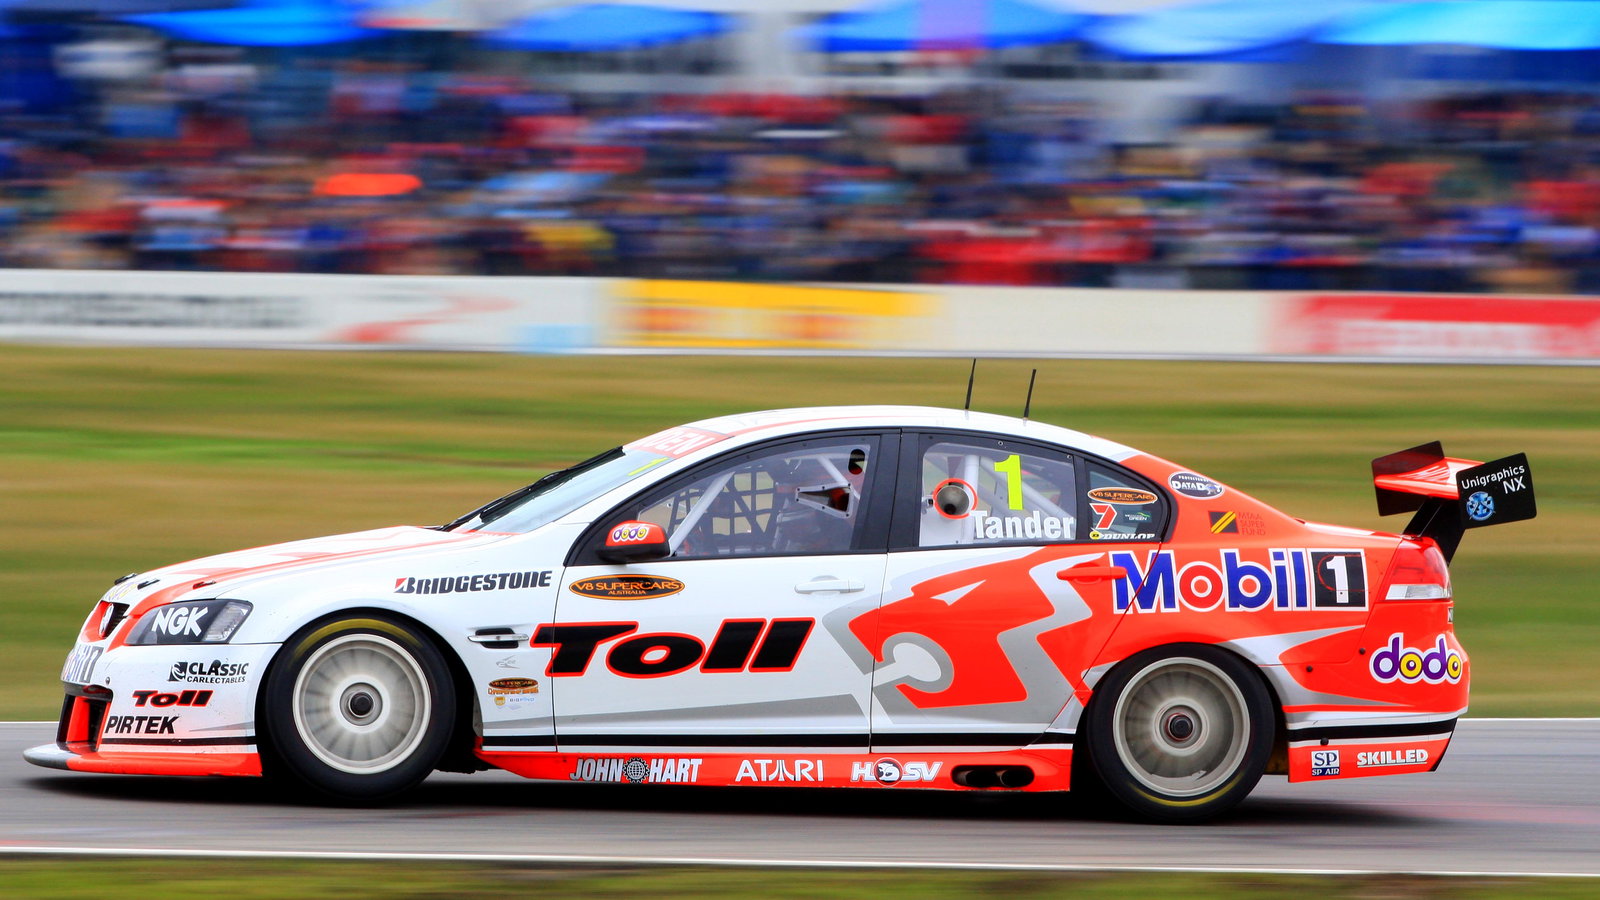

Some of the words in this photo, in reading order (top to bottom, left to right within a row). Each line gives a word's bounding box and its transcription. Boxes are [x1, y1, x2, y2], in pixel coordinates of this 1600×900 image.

[994, 455, 1023, 510] 1
[1461, 465, 1525, 490] Unigraphics
[1503, 476, 1526, 494] NX
[613, 526, 650, 542] dodo
[970, 510, 1074, 539] Tander
[1242, 528, 1267, 536] FUND
[394, 570, 552, 594] BRIDGESTONE
[574, 582, 594, 590] V8
[595, 582, 680, 590] SUPERCARS
[1109, 548, 1308, 614] Mobil
[152, 606, 208, 637] NGK
[530, 617, 816, 679] Toll
[188, 660, 250, 676] CLASSIC
[1369, 632, 1463, 685] dodo
[186, 675, 246, 684] CARLECTABLES
[132, 689, 214, 708] Toll
[104, 715, 181, 734] PIRTEK
[1314, 752, 1337, 766] SP
[1357, 749, 1428, 766] SKILLED
[569, 758, 624, 782] JOHN
[648, 758, 702, 783] HART
[735, 759, 824, 782] ATARI
[1312, 768, 1322, 776] SP
[1325, 767, 1339, 775] AIR
